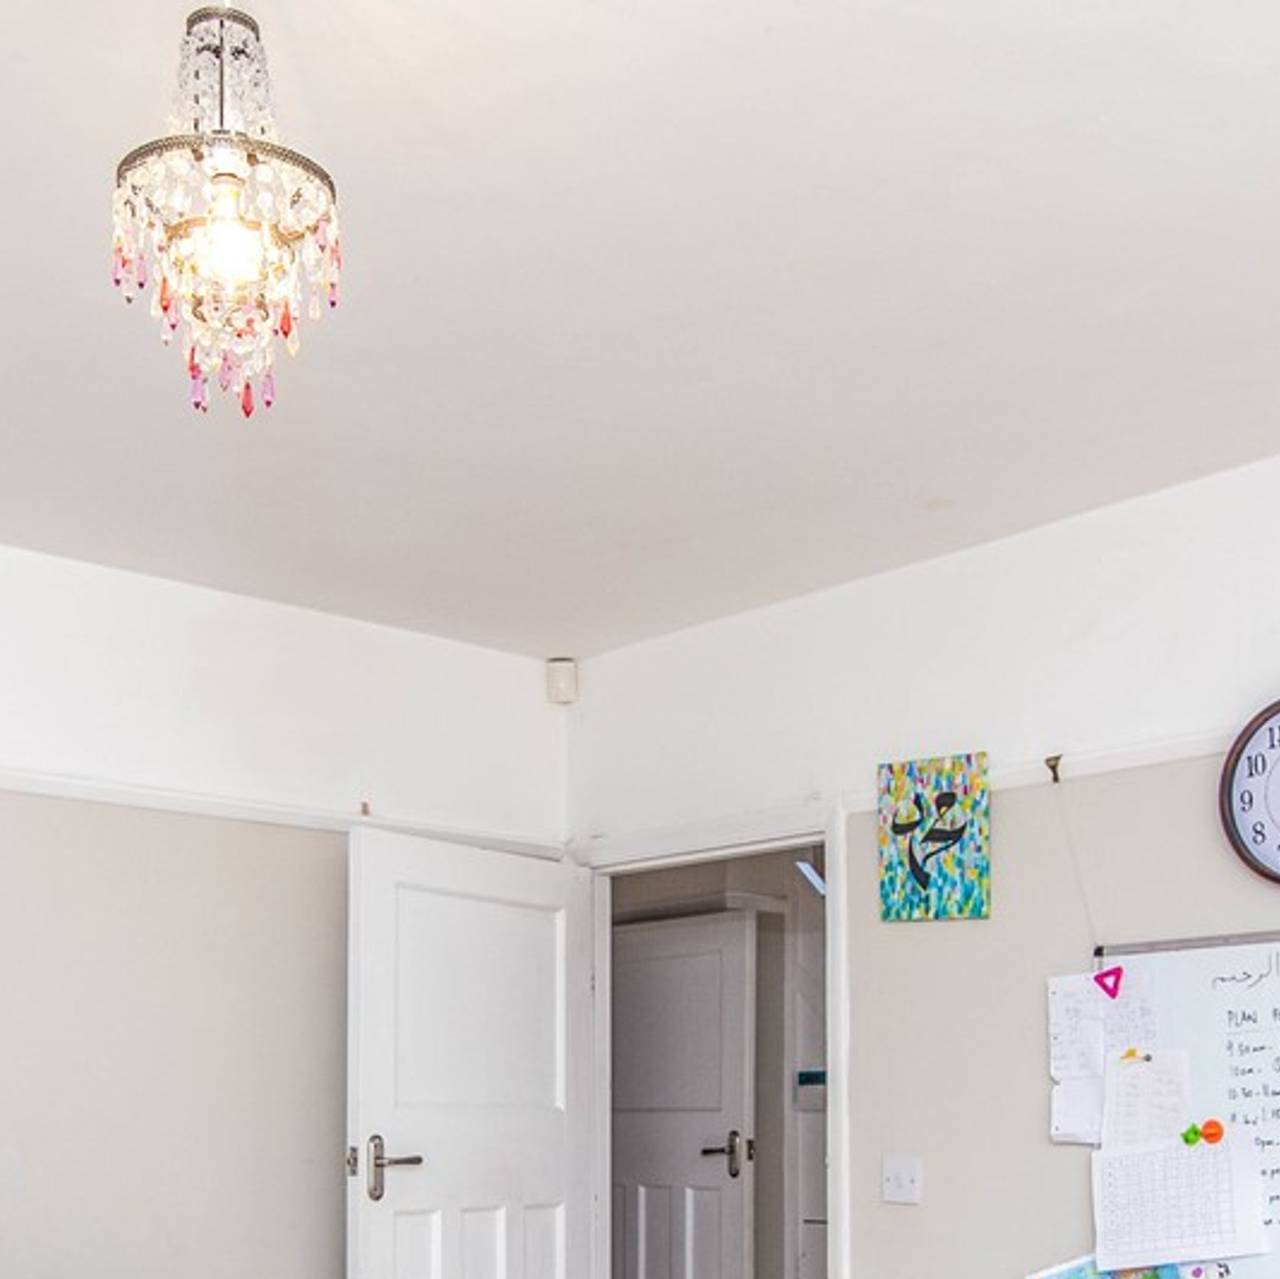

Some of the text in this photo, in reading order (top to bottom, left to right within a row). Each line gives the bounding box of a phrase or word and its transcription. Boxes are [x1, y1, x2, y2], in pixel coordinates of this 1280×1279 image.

[1247, 753, 1266, 778] 10
[1240, 790, 1253, 812] 9
[1252, 821, 1266, 845] 8
[1227, 1010, 1258, 1027] PLAN
